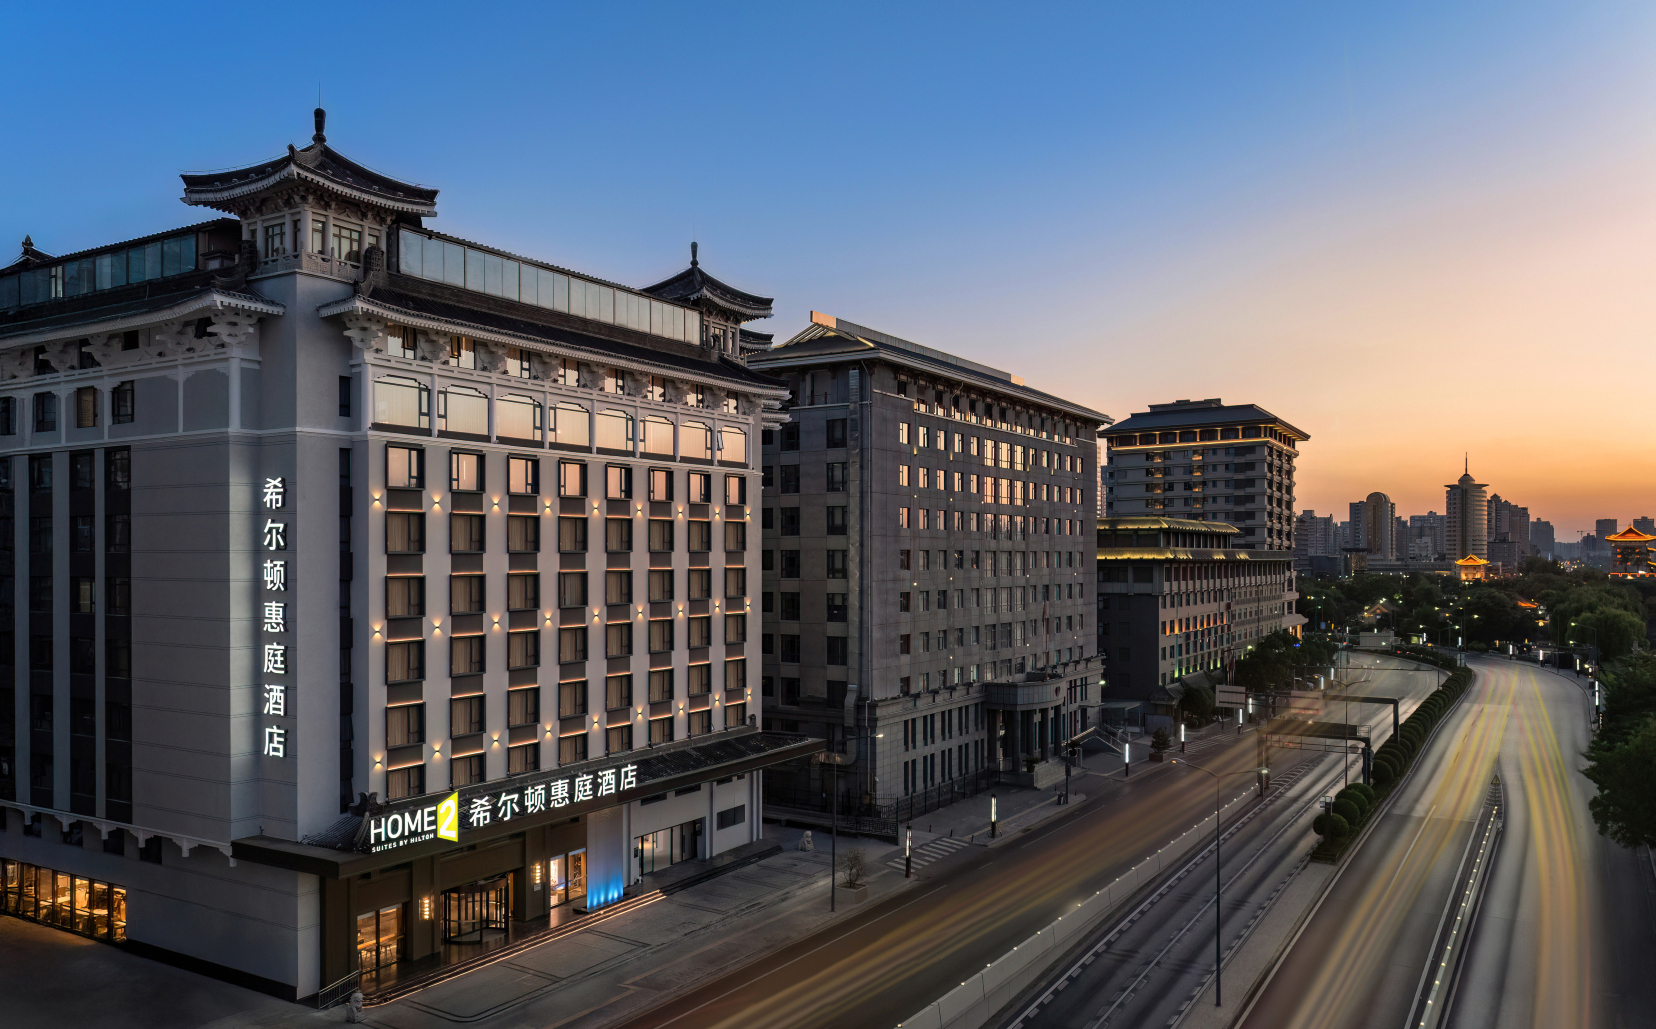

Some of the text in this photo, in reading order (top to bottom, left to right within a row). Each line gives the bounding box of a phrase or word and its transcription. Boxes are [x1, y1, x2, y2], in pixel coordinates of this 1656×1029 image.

[262, 476, 285, 758] 希尔顿惠庭酒店
[469, 763, 638, 827] 希尔顿惠庭酒店
[371, 833, 434, 853] SUITES BY HILTON
